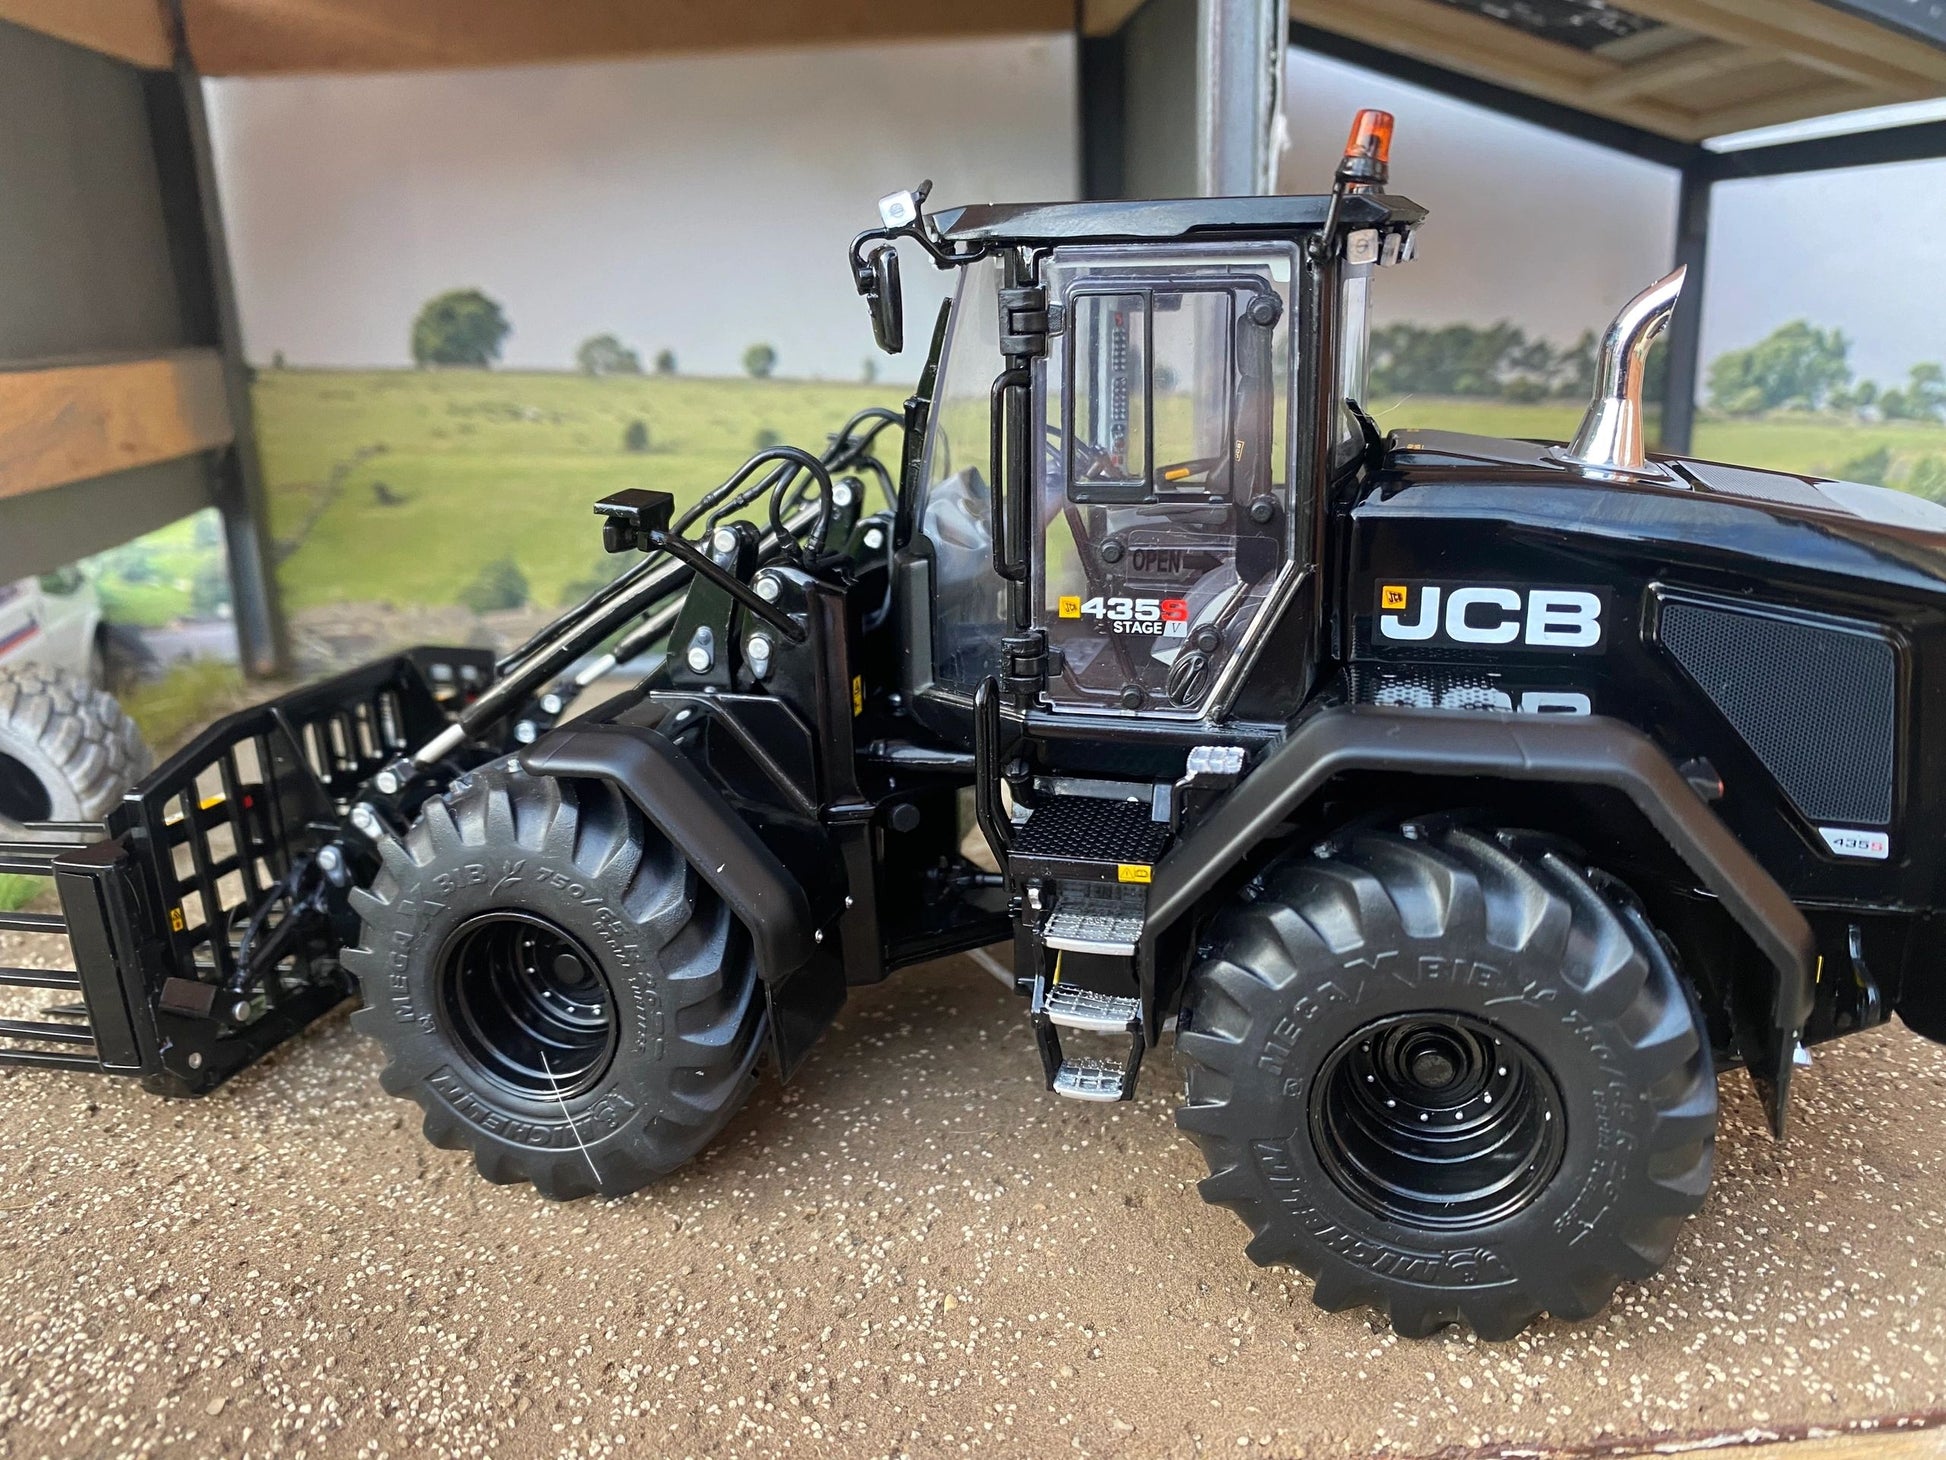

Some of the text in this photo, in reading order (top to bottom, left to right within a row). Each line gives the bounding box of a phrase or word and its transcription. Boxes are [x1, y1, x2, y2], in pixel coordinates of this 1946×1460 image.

[1132, 549, 1180, 573] OPEN
[1081, 597, 1189, 622] 435S
[1380, 586, 1602, 648] JCB
[1113, 621, 1163, 635] STAGE
[1833, 838, 1883, 852] 435S
[433, 863, 488, 894] BIB
